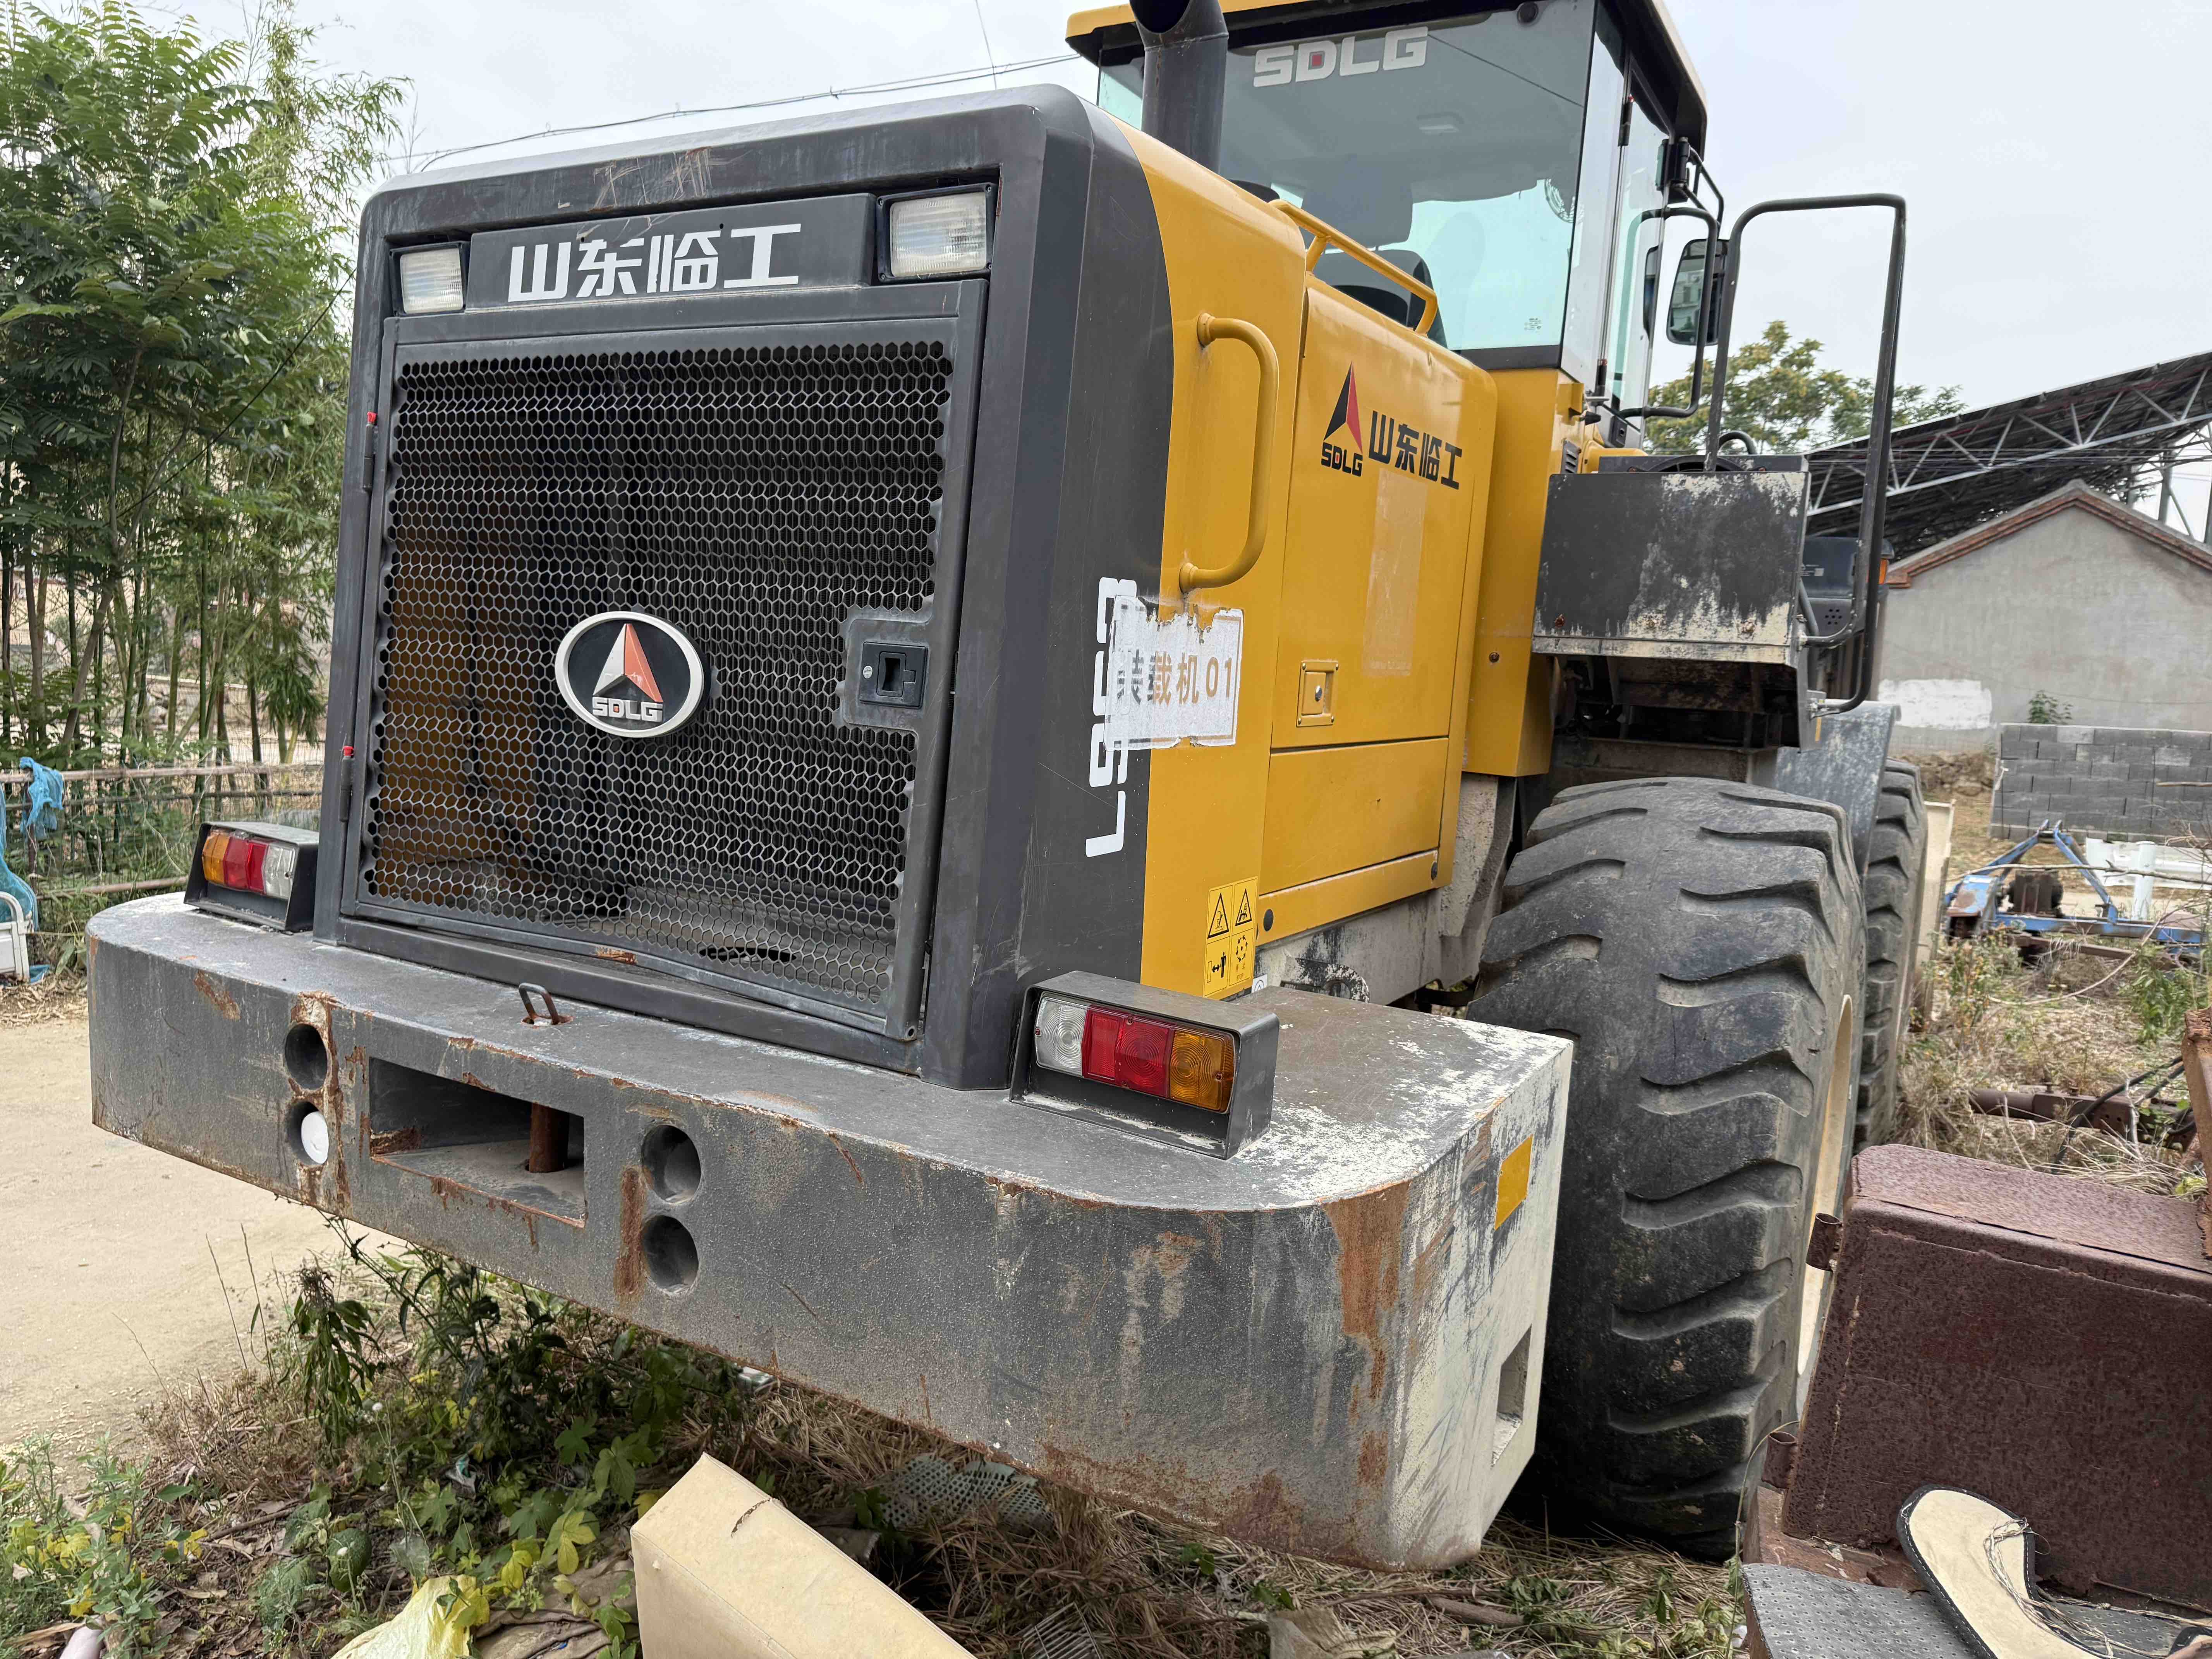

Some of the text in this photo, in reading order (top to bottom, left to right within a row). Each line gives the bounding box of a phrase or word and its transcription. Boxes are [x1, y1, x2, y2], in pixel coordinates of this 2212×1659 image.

[1253, 26, 1429, 88] SDLG
[508, 223, 802, 302] 山东临工
[1321, 442, 1363, 477] SDLG
[1368, 410, 1462, 490] 山东临工
[592, 696, 663, 723] SDLG
